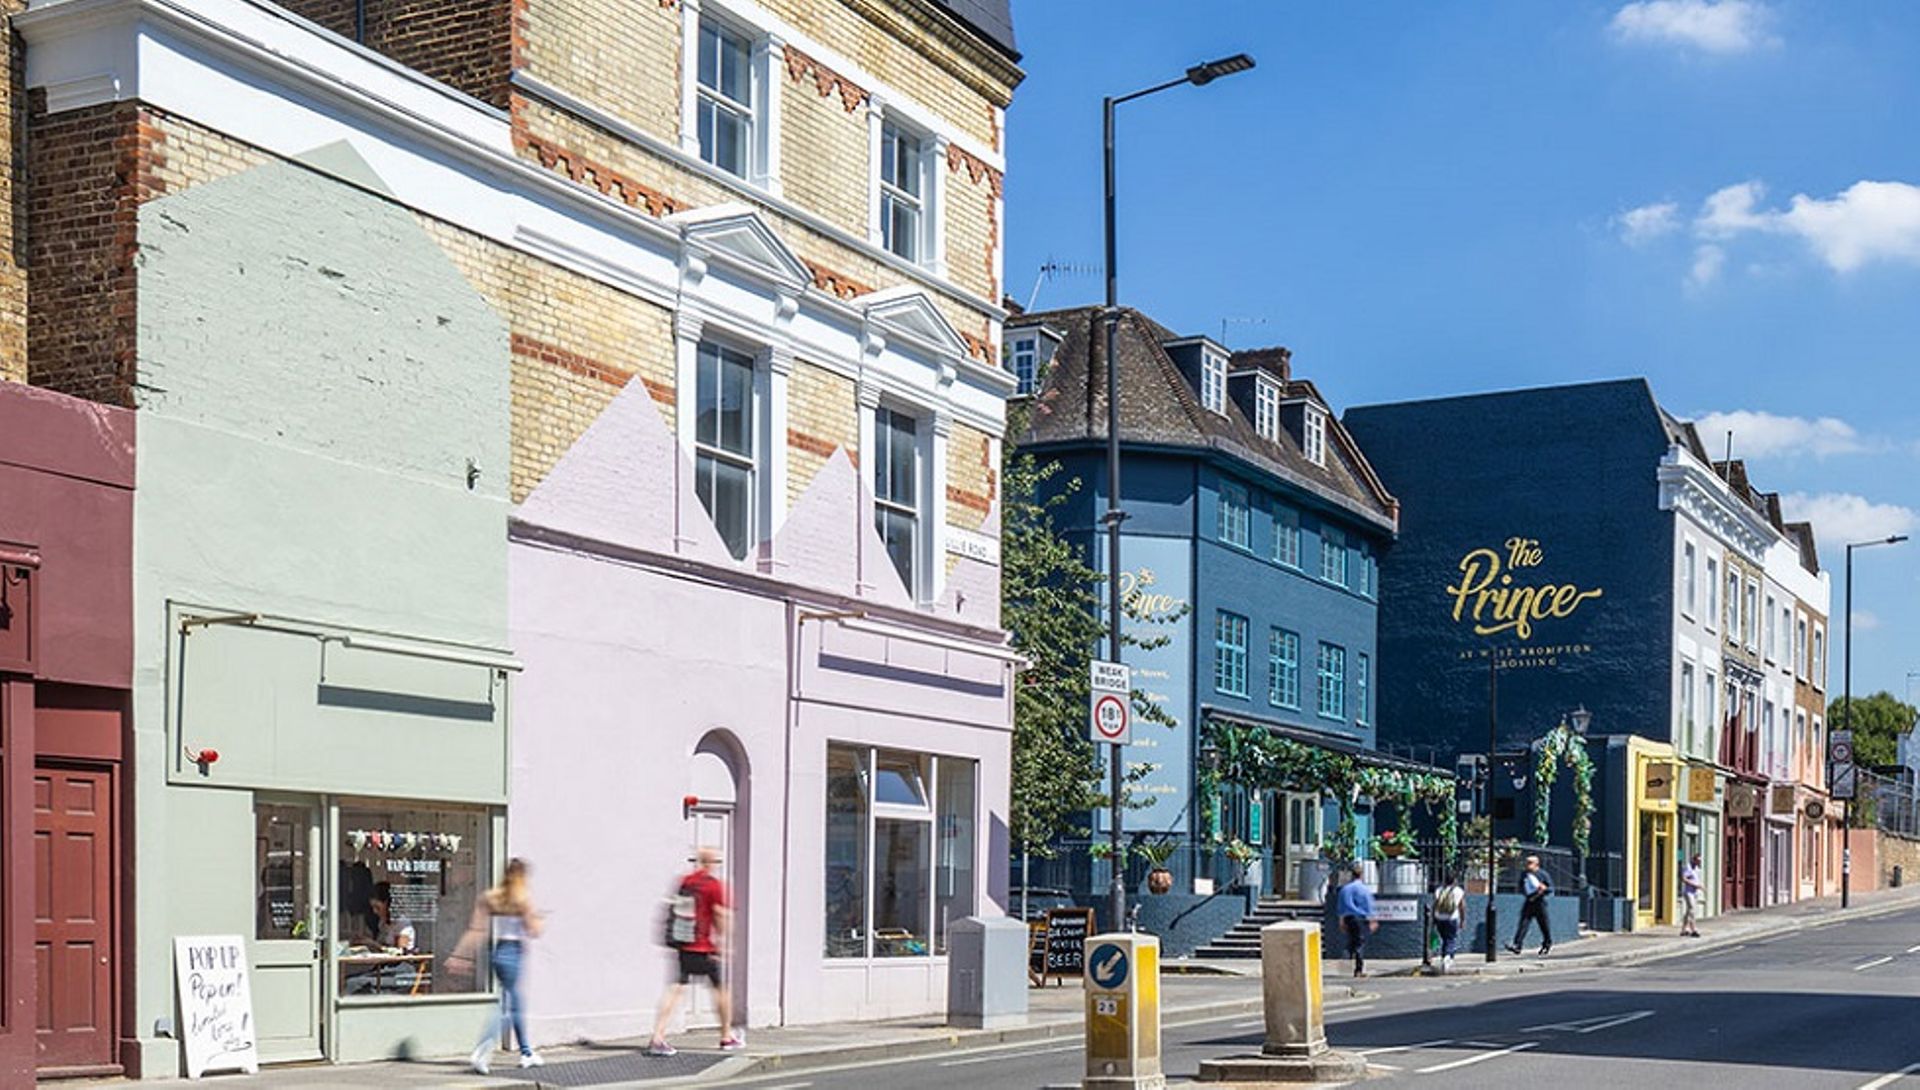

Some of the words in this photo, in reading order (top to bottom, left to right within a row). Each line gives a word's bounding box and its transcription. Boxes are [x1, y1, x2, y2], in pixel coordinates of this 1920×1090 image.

[969, 542, 987, 558] ROAD
[1505, 537, 1543, 570] The
[1118, 572, 1185, 620] Pnce
[1447, 549, 1602, 639] Prince
[1460, 650, 1473, 658] AT
[1480, 648, 1512, 656] WST
[1520, 644, 1591, 655] BROMPTON
[1494, 657, 1557, 668] ROSSING
[1099, 667, 1123, 677] WEAK
[1095, 676, 1126, 689] BRIDGE
[188, 946, 217, 969] POP
[220, 945, 240, 968] UP
[1048, 951, 1082, 968] BEER
